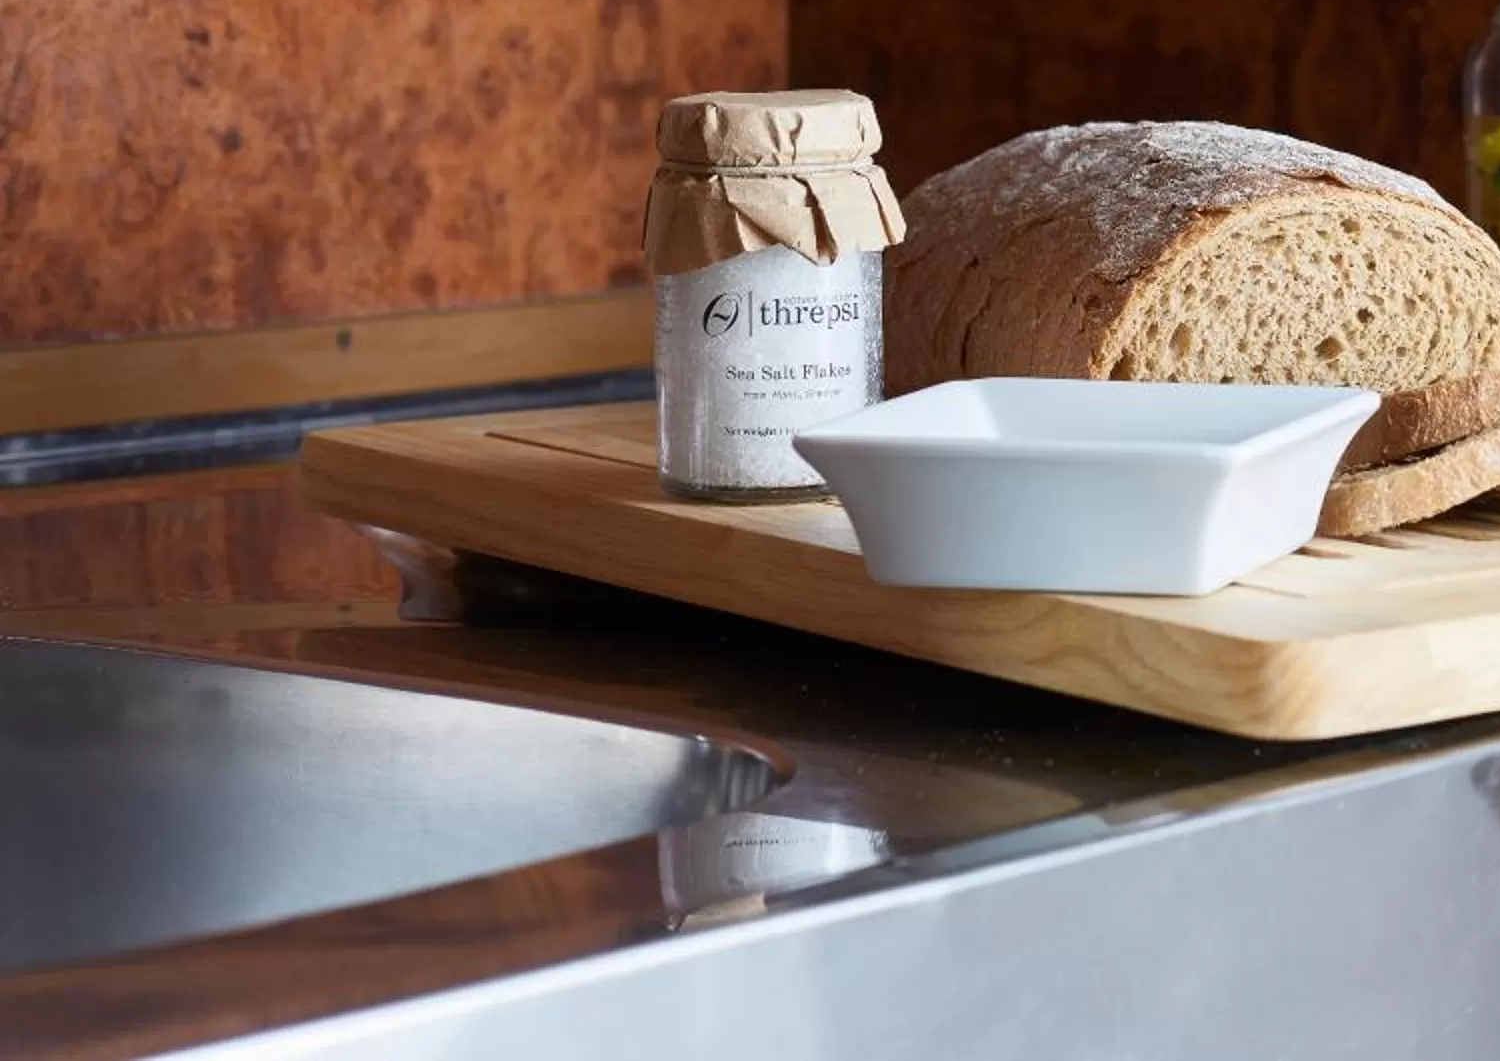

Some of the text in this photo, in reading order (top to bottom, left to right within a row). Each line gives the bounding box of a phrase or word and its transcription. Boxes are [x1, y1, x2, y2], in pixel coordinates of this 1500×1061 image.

[760, 293, 860, 330] threpsi
[725, 362, 851, 380] Sea Salt Flakes
